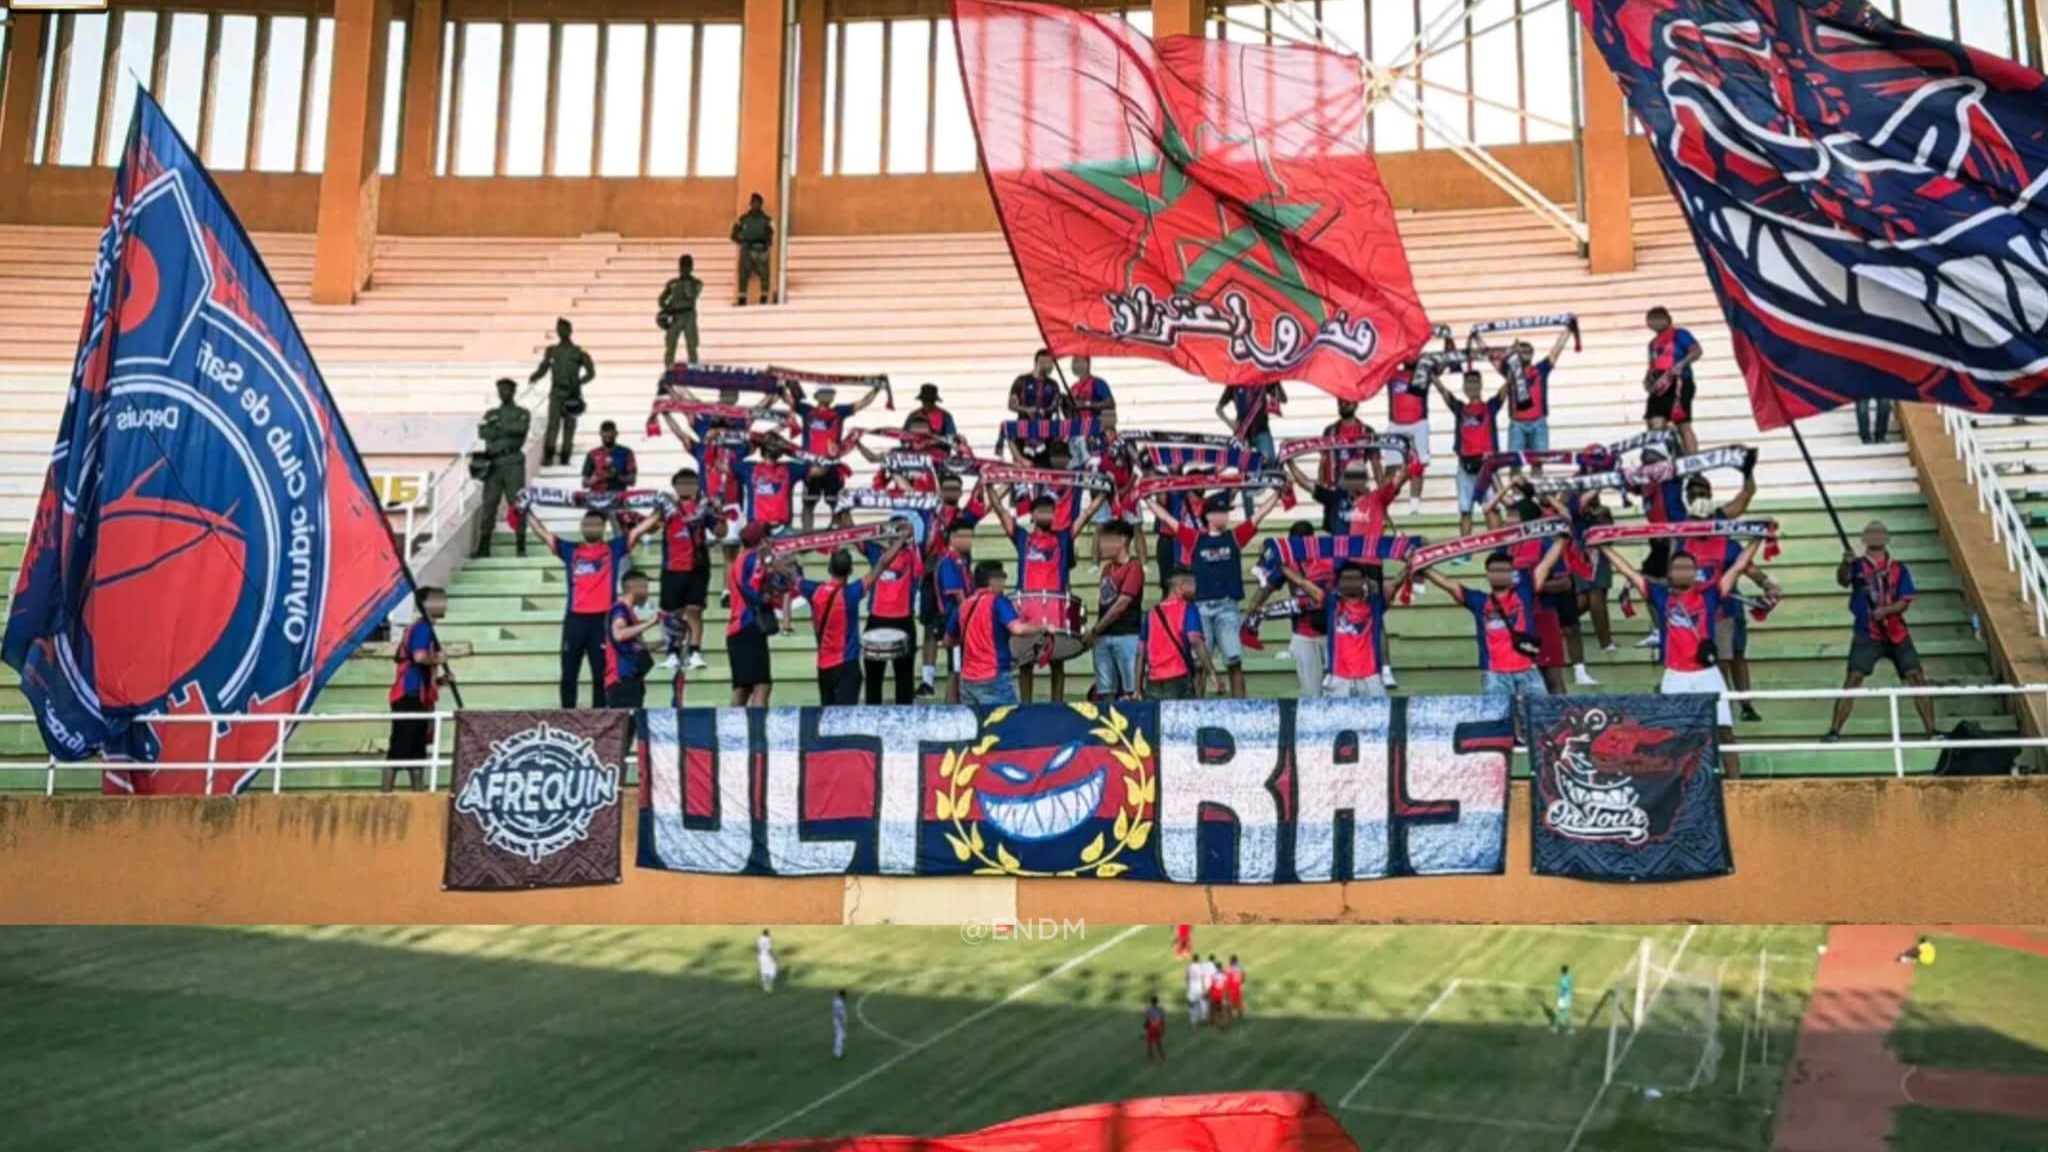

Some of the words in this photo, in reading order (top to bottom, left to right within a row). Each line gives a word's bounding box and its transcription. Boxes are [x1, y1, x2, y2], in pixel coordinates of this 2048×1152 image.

[461, 766, 614, 813] AFREQUIN
[1547, 799, 1585, 830] On
[1583, 801, 1648, 829] Tour
